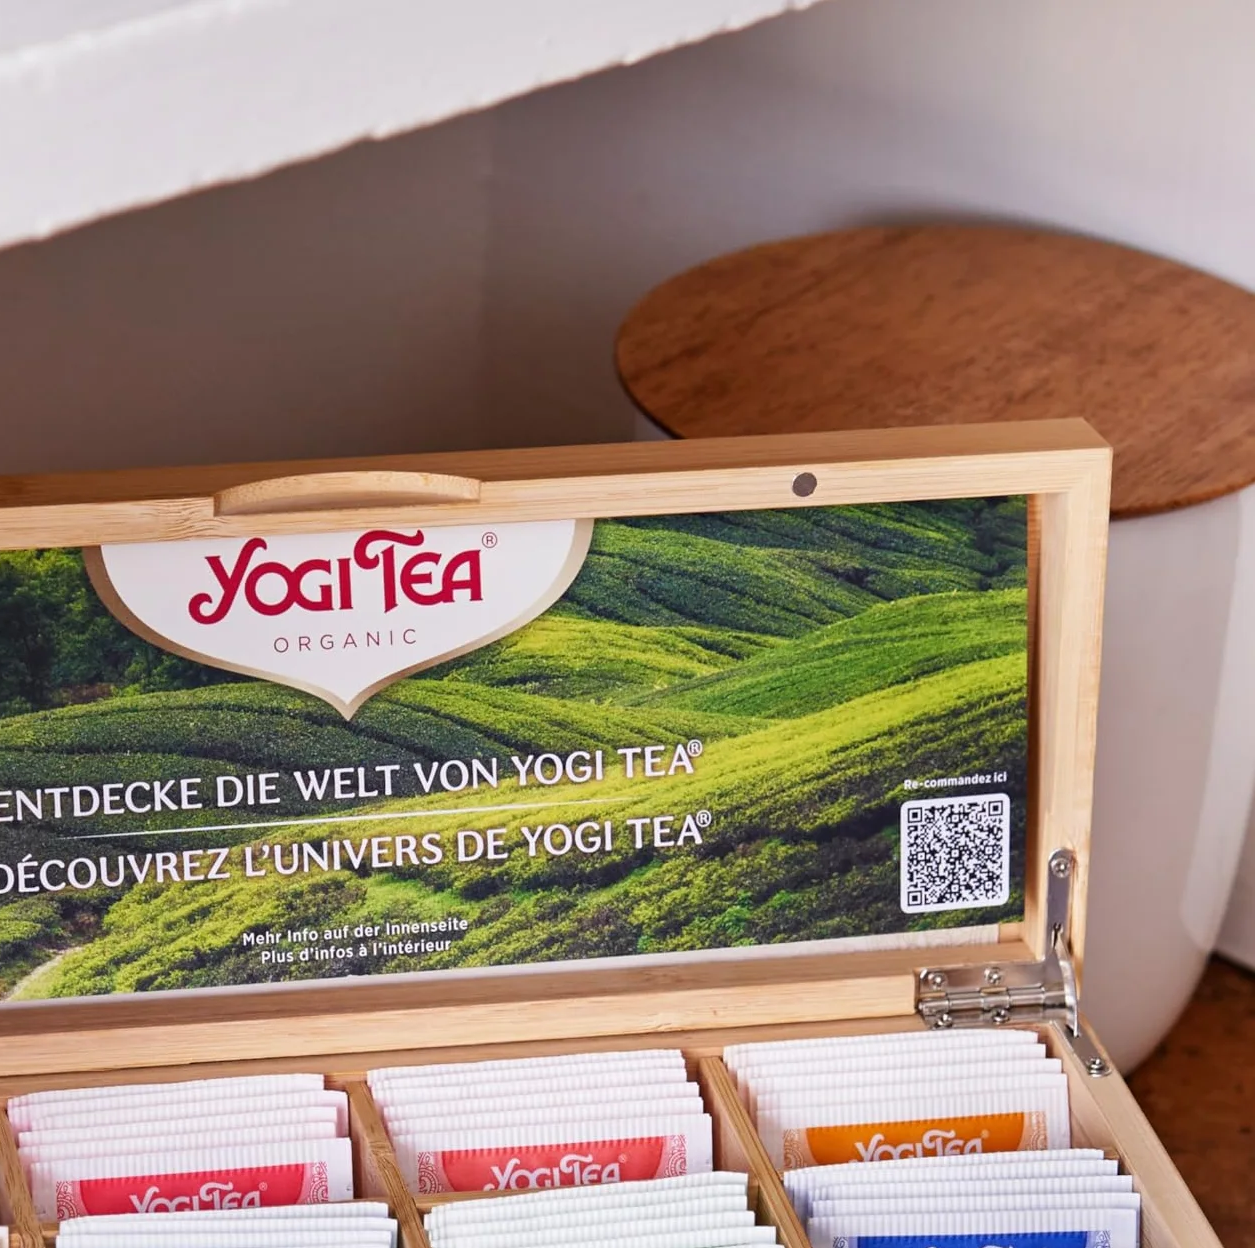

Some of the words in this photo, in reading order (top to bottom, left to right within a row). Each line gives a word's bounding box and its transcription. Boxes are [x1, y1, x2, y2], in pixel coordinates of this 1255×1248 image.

[188, 536, 353, 625] YOGI
[273, 628, 418, 654] ORGANIC
[215, 772, 281, 808] DIE
[293, 764, 401, 801] WELT
[413, 757, 498, 793] VON
[511, 749, 604, 787] YOGI
[903, 773, 992, 790] Re-commandez
[993, 771, 1008, 783] ici
[245, 832, 444, 879] L’UNIVERS
[457, 827, 509, 863] DE
[521, 820, 613, 857] YOGI
[242, 930, 282, 947] Mehr
[287, 927, 319, 943] Info
[323, 925, 349, 941] auf
[354, 923, 380, 938] der
[386, 917, 469, 936] Innenseite
[261, 950, 294, 965] Plus
[299, 945, 354, 962] d'infos
[358, 942, 368, 957] à
[372, 938, 452, 956] l'intérieur
[849, 1133, 923, 1164] YOGI
[483, 1157, 561, 1192] YOGI
